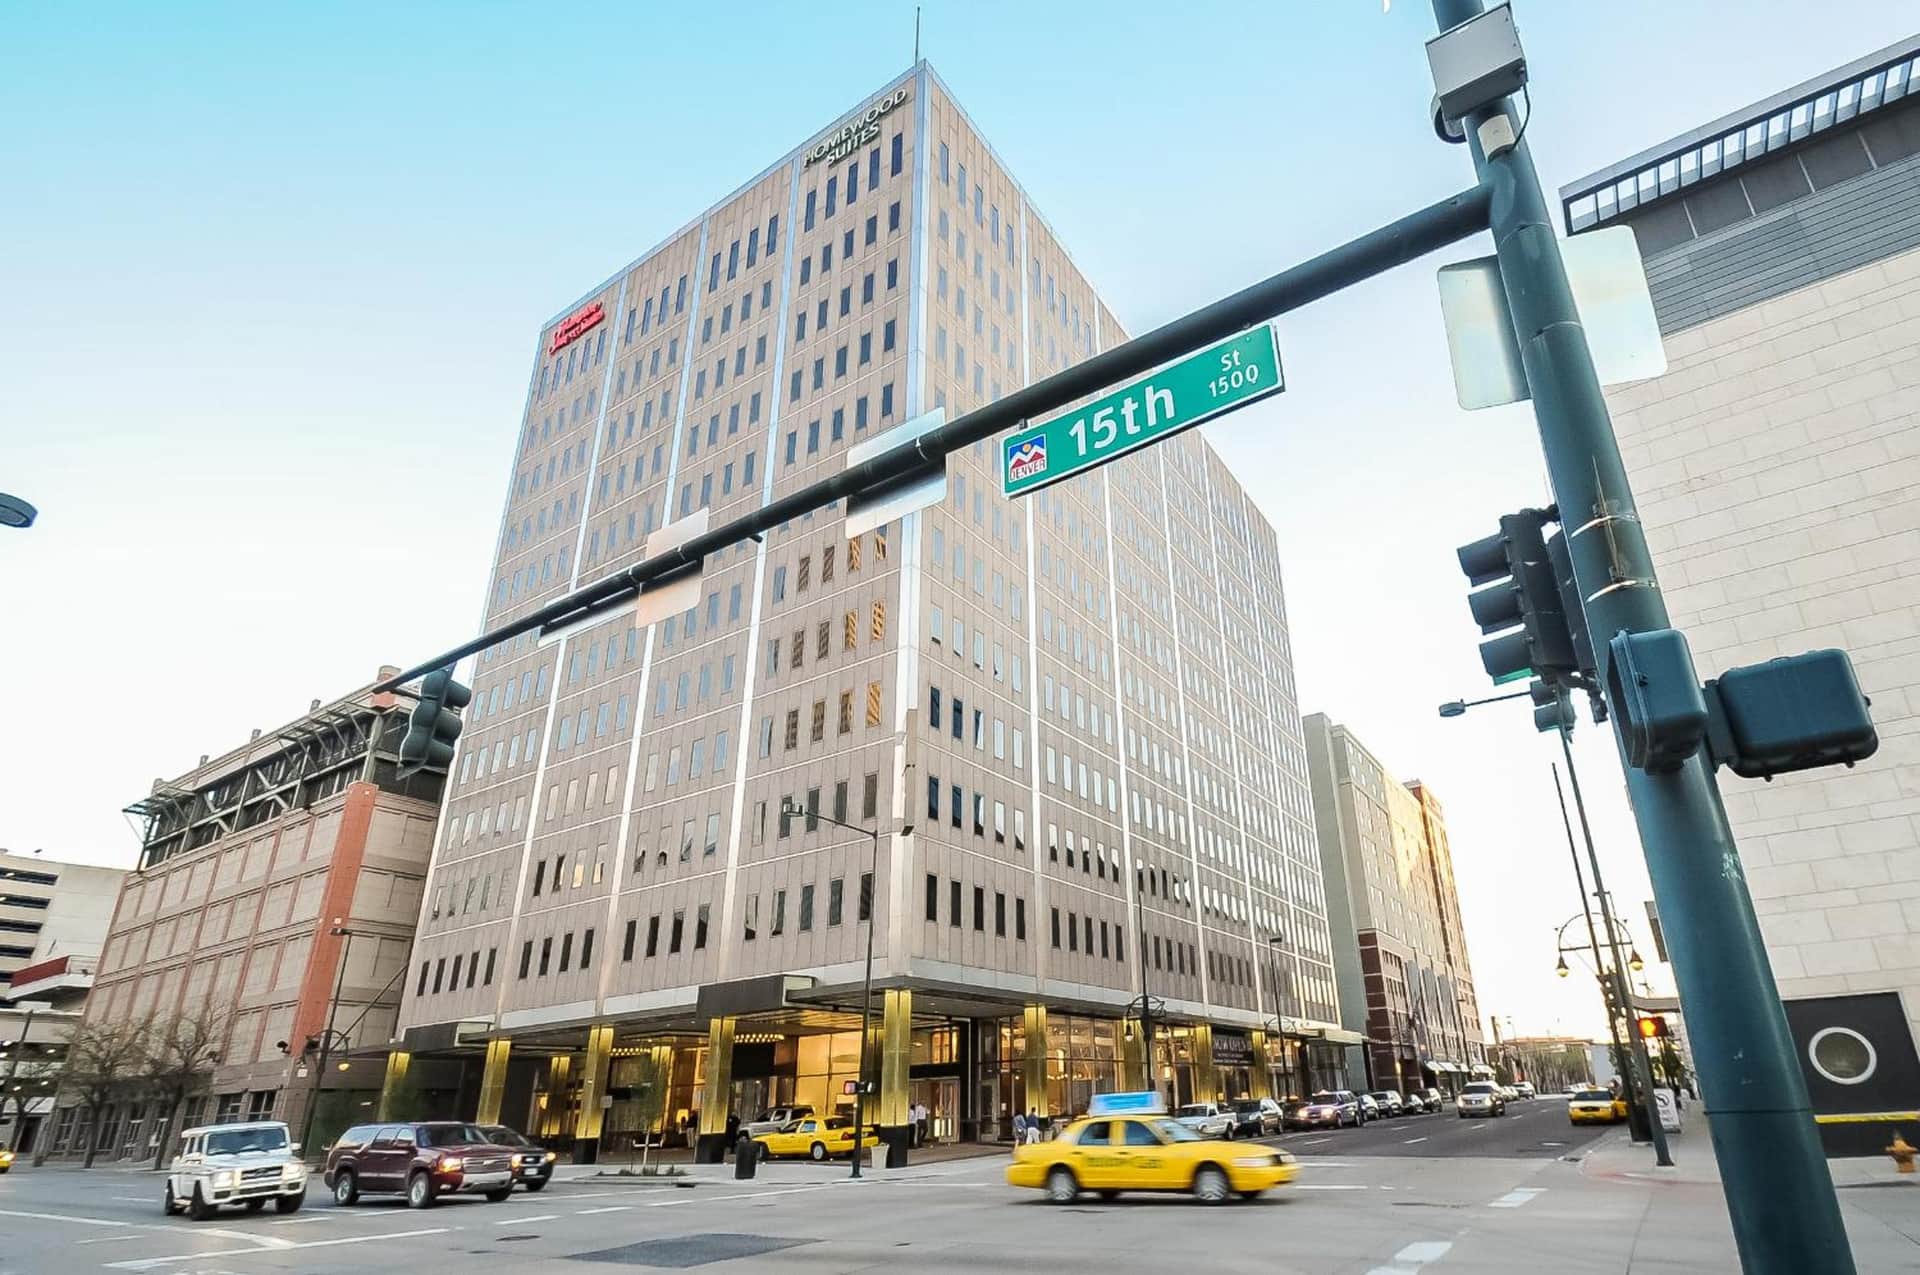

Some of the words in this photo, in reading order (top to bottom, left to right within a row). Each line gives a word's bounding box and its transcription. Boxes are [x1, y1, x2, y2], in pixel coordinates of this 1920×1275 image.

[804, 89, 906, 167] HOMEWOOD
[826, 120, 881, 168] SUITES
[1208, 364, 1259, 398] 1500
[1220, 349, 1242, 372] St
[1068, 386, 1176, 457] 15th
[1010, 459, 1046, 480] DENVER
